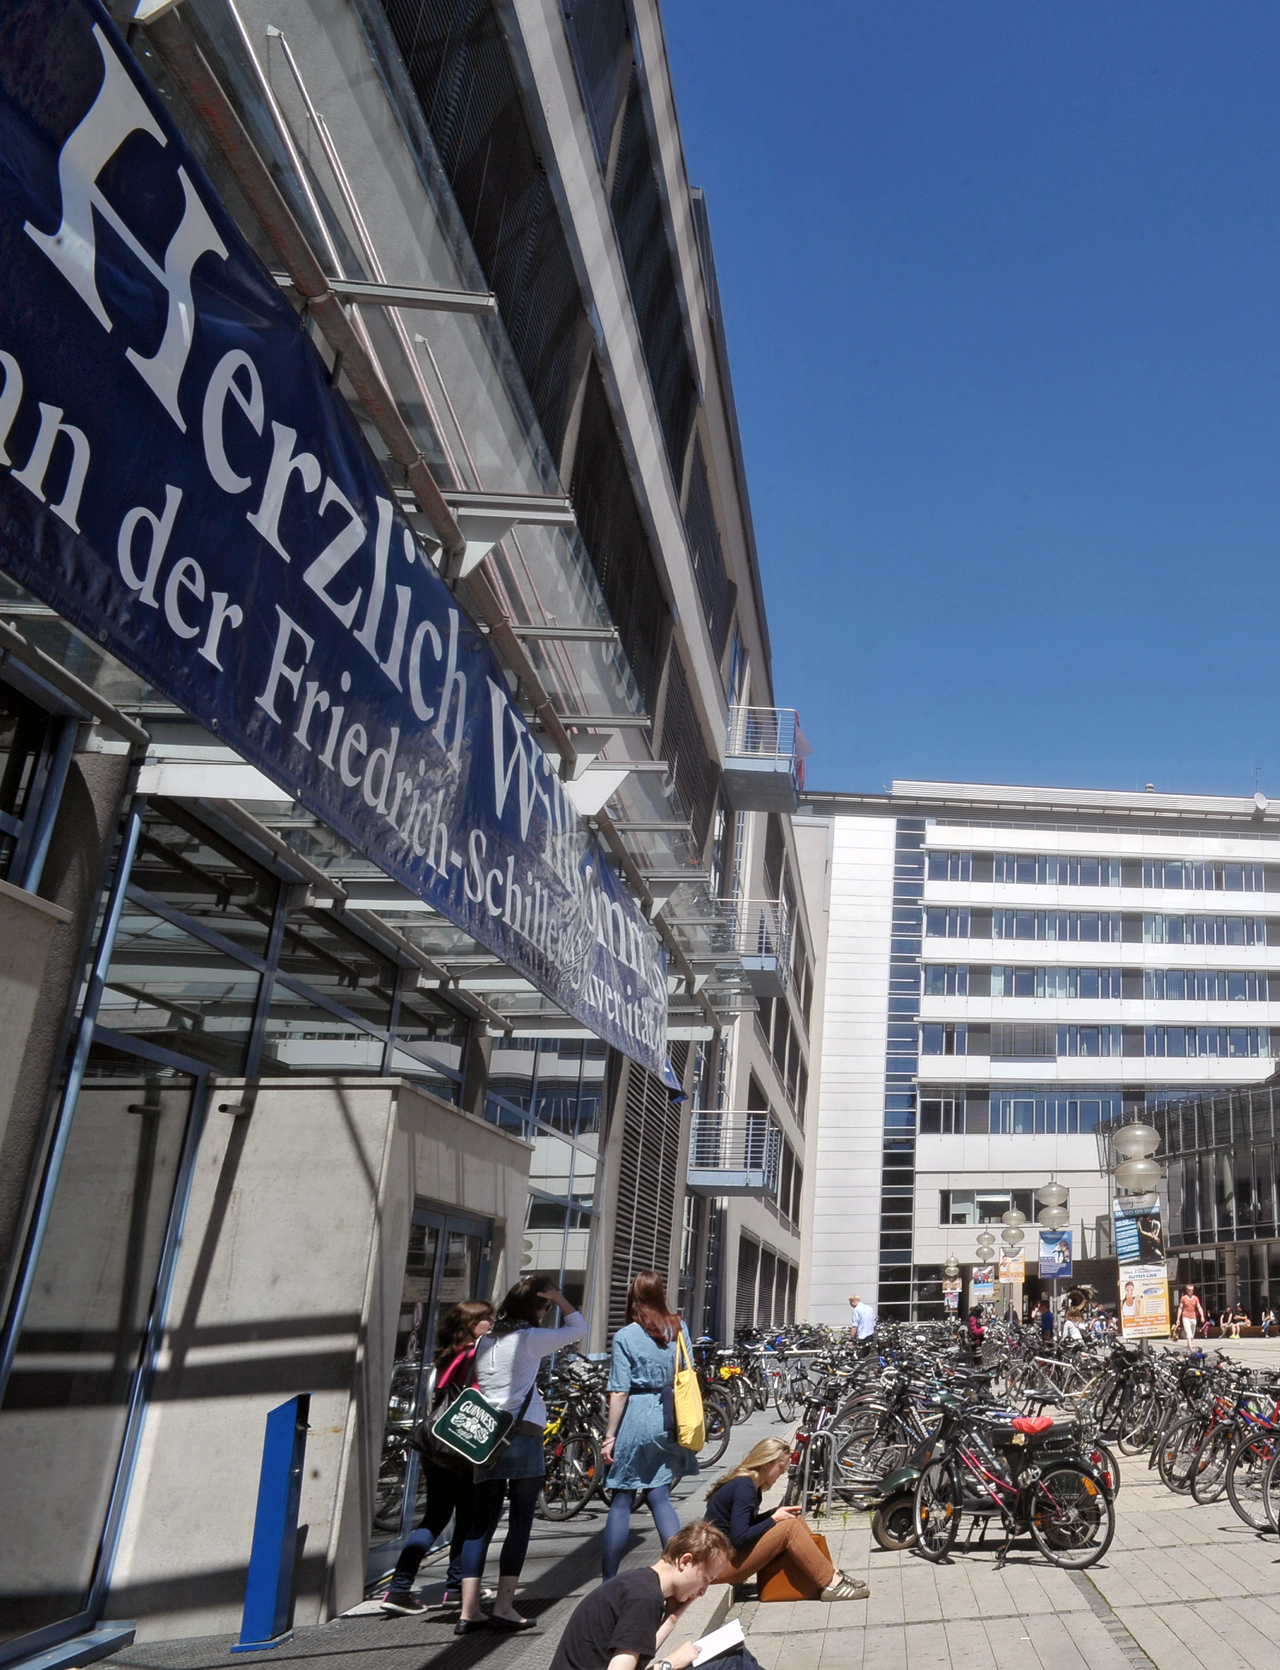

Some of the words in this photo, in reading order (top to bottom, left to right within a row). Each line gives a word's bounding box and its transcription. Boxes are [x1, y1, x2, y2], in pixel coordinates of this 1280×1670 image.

[24, 22, 467, 774] Herzlich
[117, 483, 244, 673] der
[459, 1400, 498, 1433] GUINNESS
